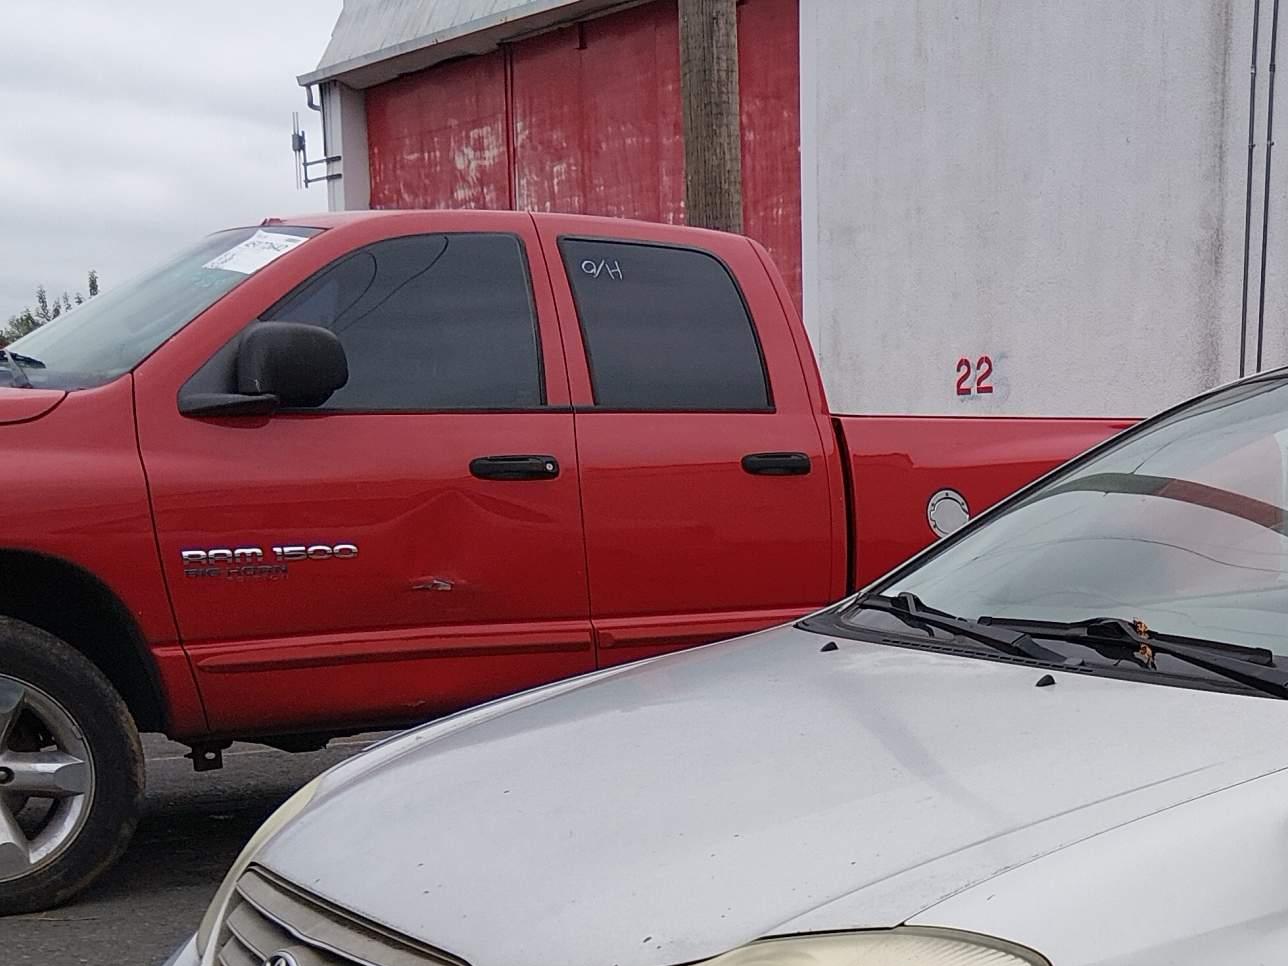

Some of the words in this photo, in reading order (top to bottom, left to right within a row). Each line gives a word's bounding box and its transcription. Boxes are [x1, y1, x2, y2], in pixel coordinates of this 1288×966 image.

[956, 355, 993, 396] 22
[181, 548, 264, 565] RAM
[272, 543, 359, 561] 1500
